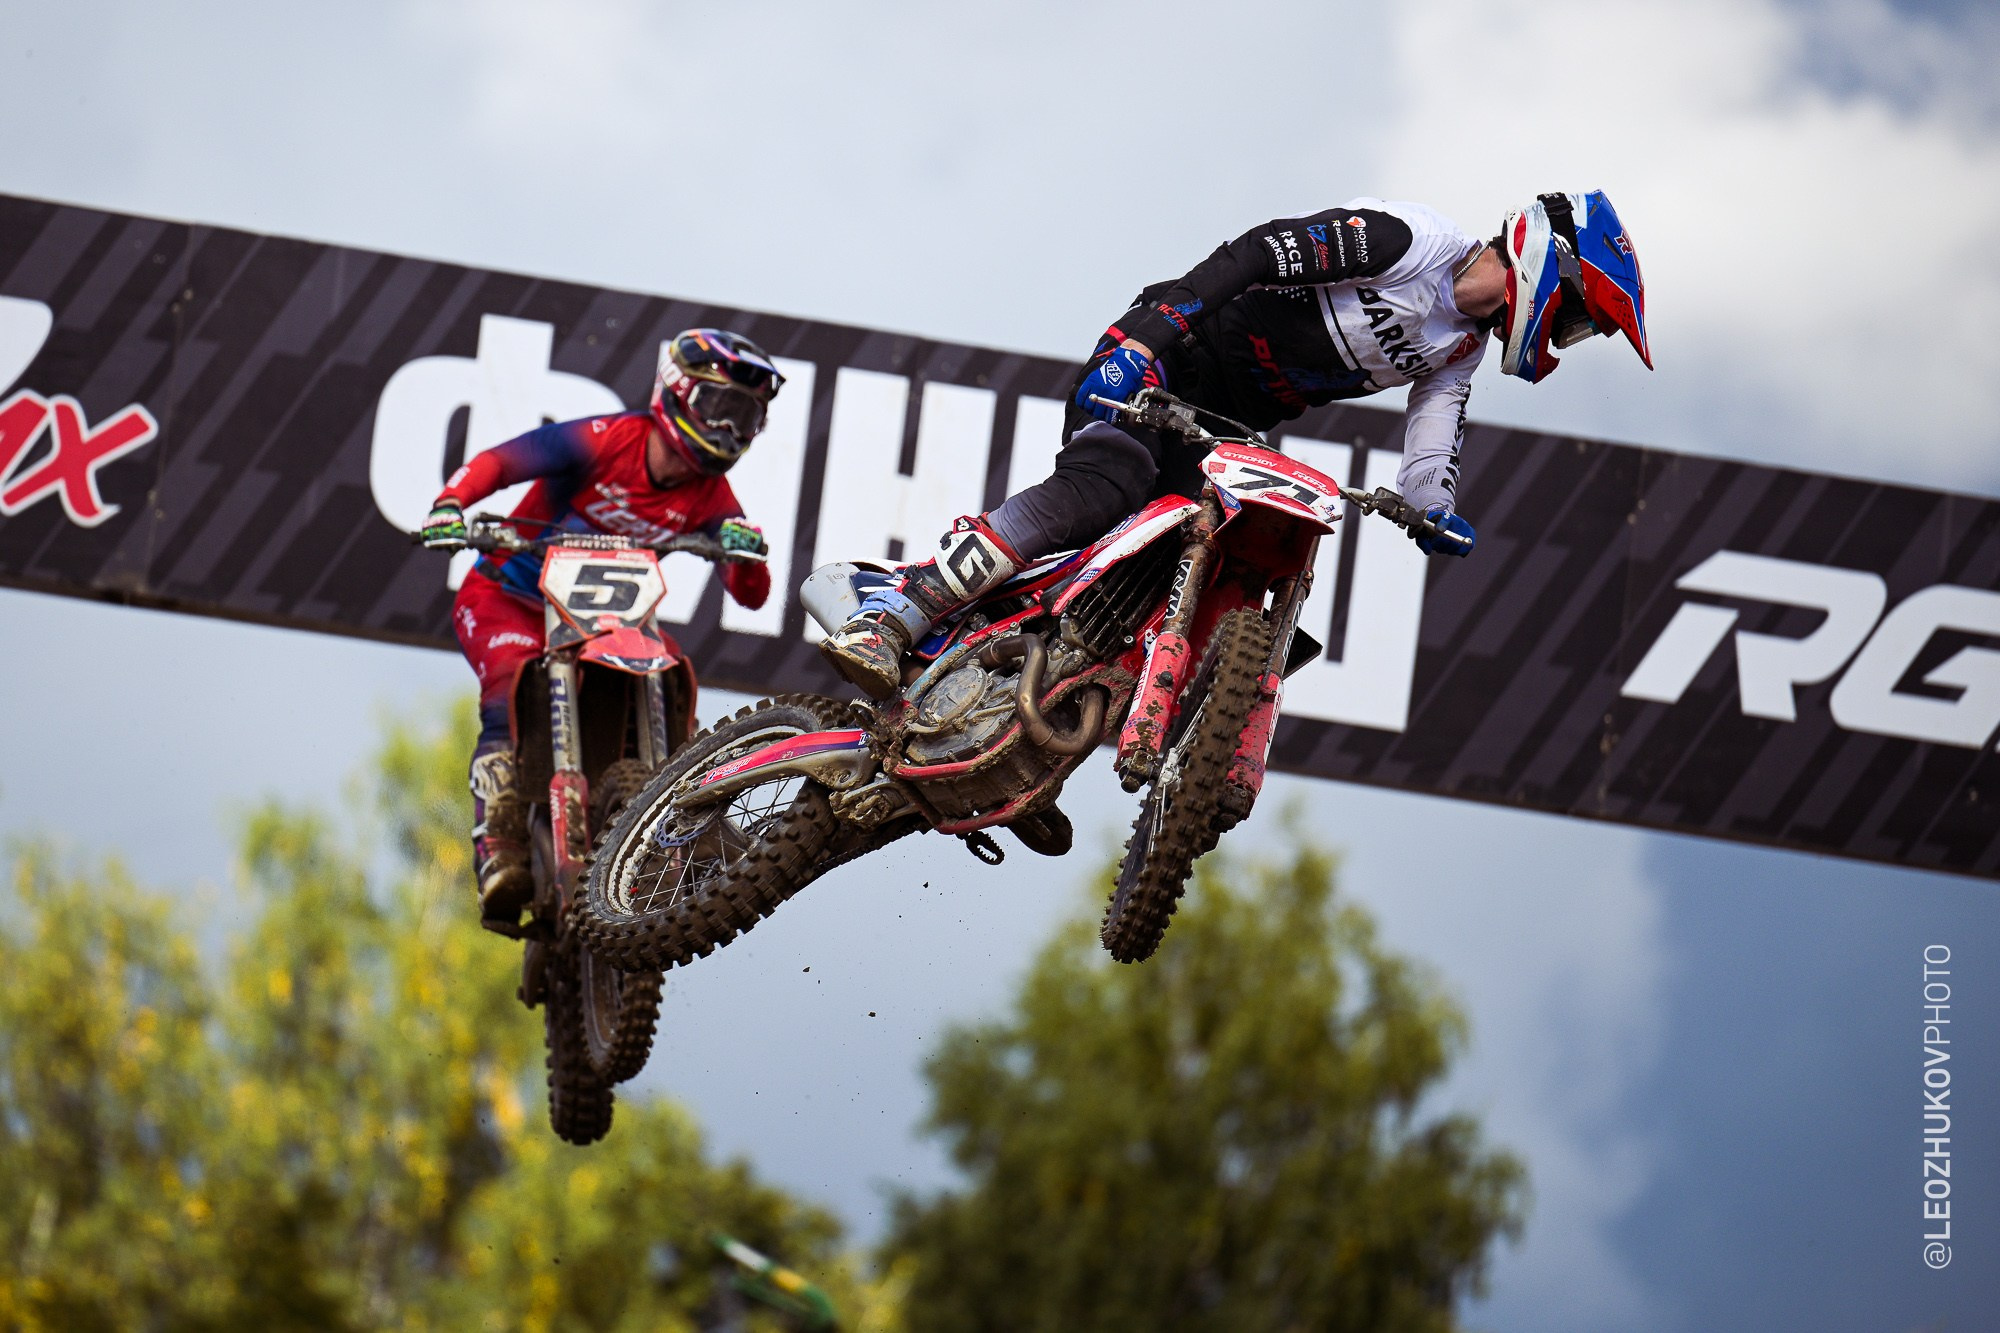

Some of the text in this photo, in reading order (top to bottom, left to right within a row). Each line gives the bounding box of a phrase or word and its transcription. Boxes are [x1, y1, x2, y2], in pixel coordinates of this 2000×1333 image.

[1264, 235, 1287, 277] DARKSIDE
[1357, 227, 1369, 263] NOMAD
[1157, 303, 1190, 334] ACTIO
[1227, 466, 1321, 506] 71
[566, 564, 649, 612] 5
[1620, 549, 2000, 754] RG
